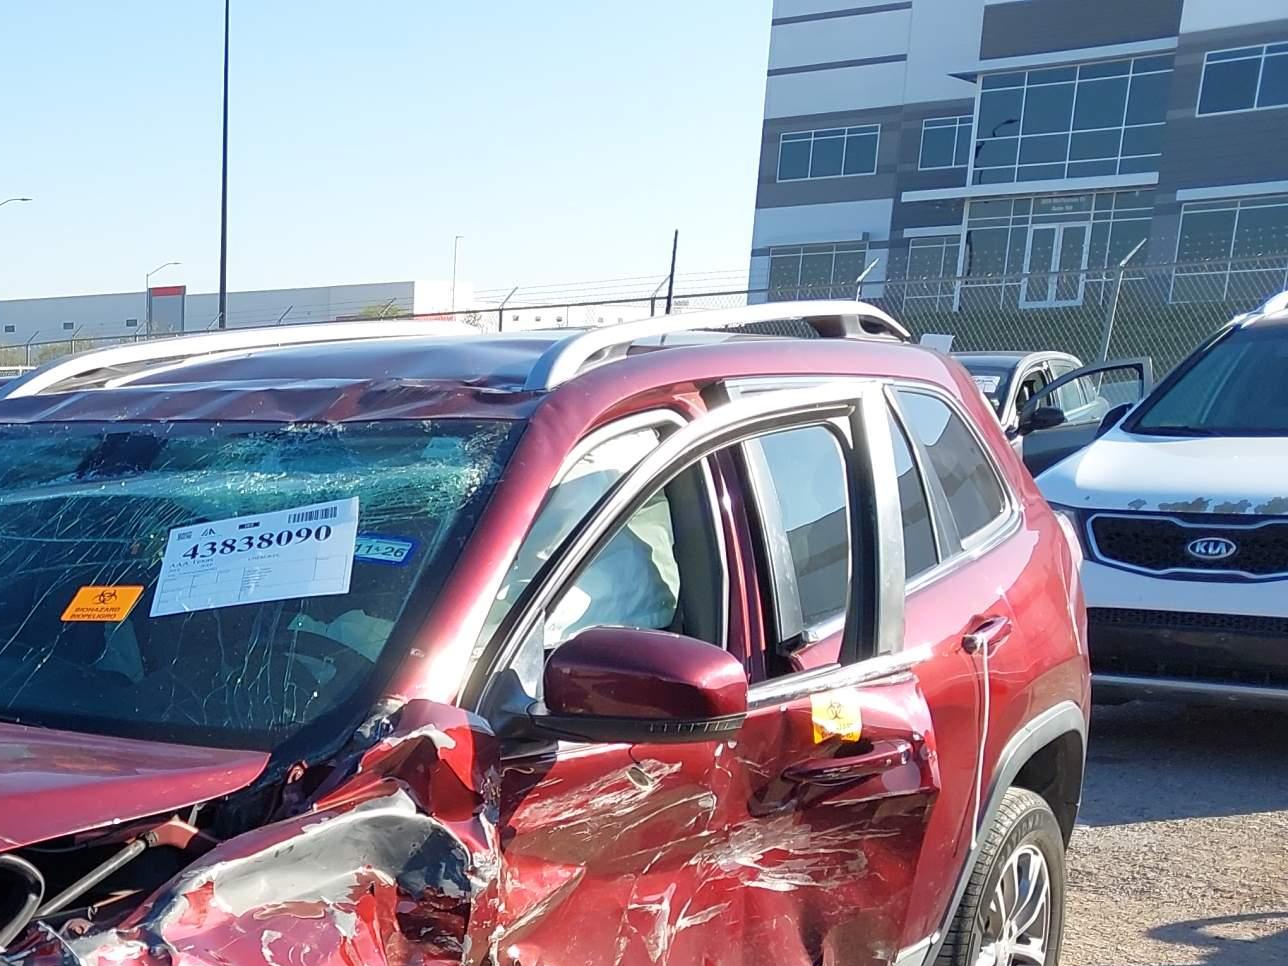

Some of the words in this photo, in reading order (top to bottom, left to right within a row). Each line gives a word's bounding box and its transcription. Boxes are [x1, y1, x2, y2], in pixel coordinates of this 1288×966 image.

[182, 525, 332, 560] 43838090
[1195, 541, 1227, 554] KIA
[382, 545, 409, 557] 26
